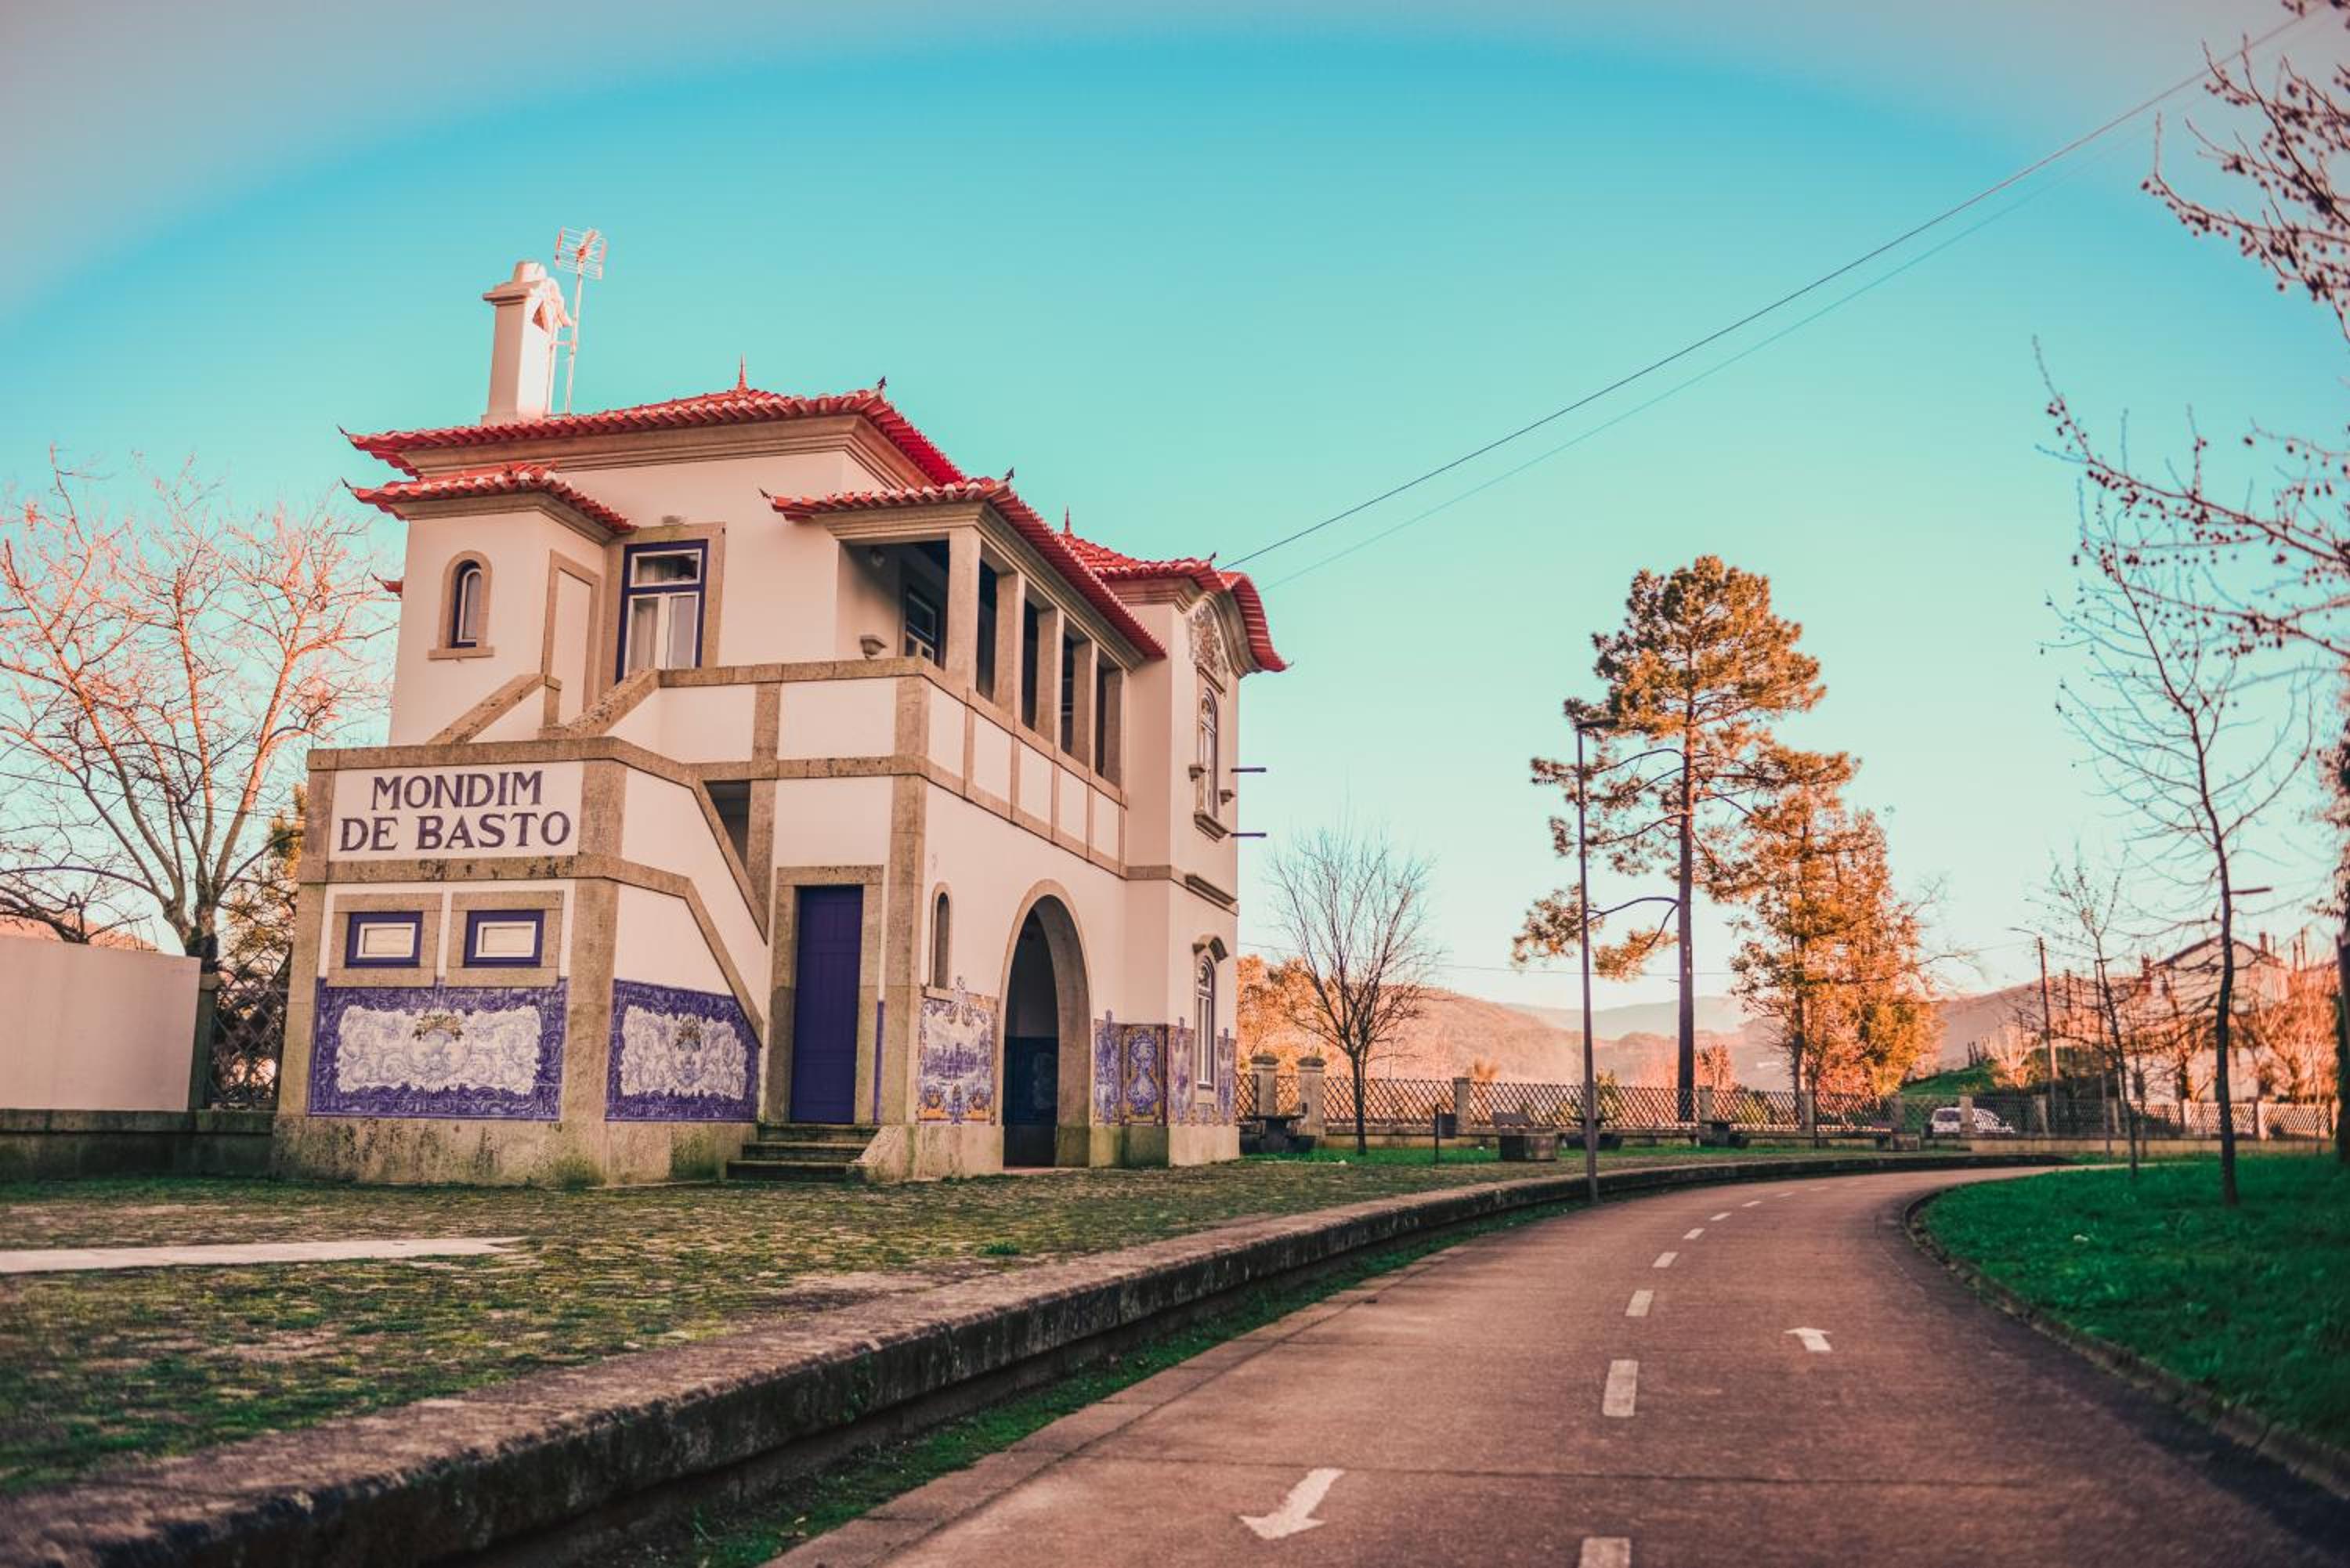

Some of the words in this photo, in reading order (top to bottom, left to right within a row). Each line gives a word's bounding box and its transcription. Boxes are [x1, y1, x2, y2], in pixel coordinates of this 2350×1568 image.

[371, 770, 543, 811] MONDIM
[338, 817, 398, 851] DE
[415, 811, 571, 850] BASTO
